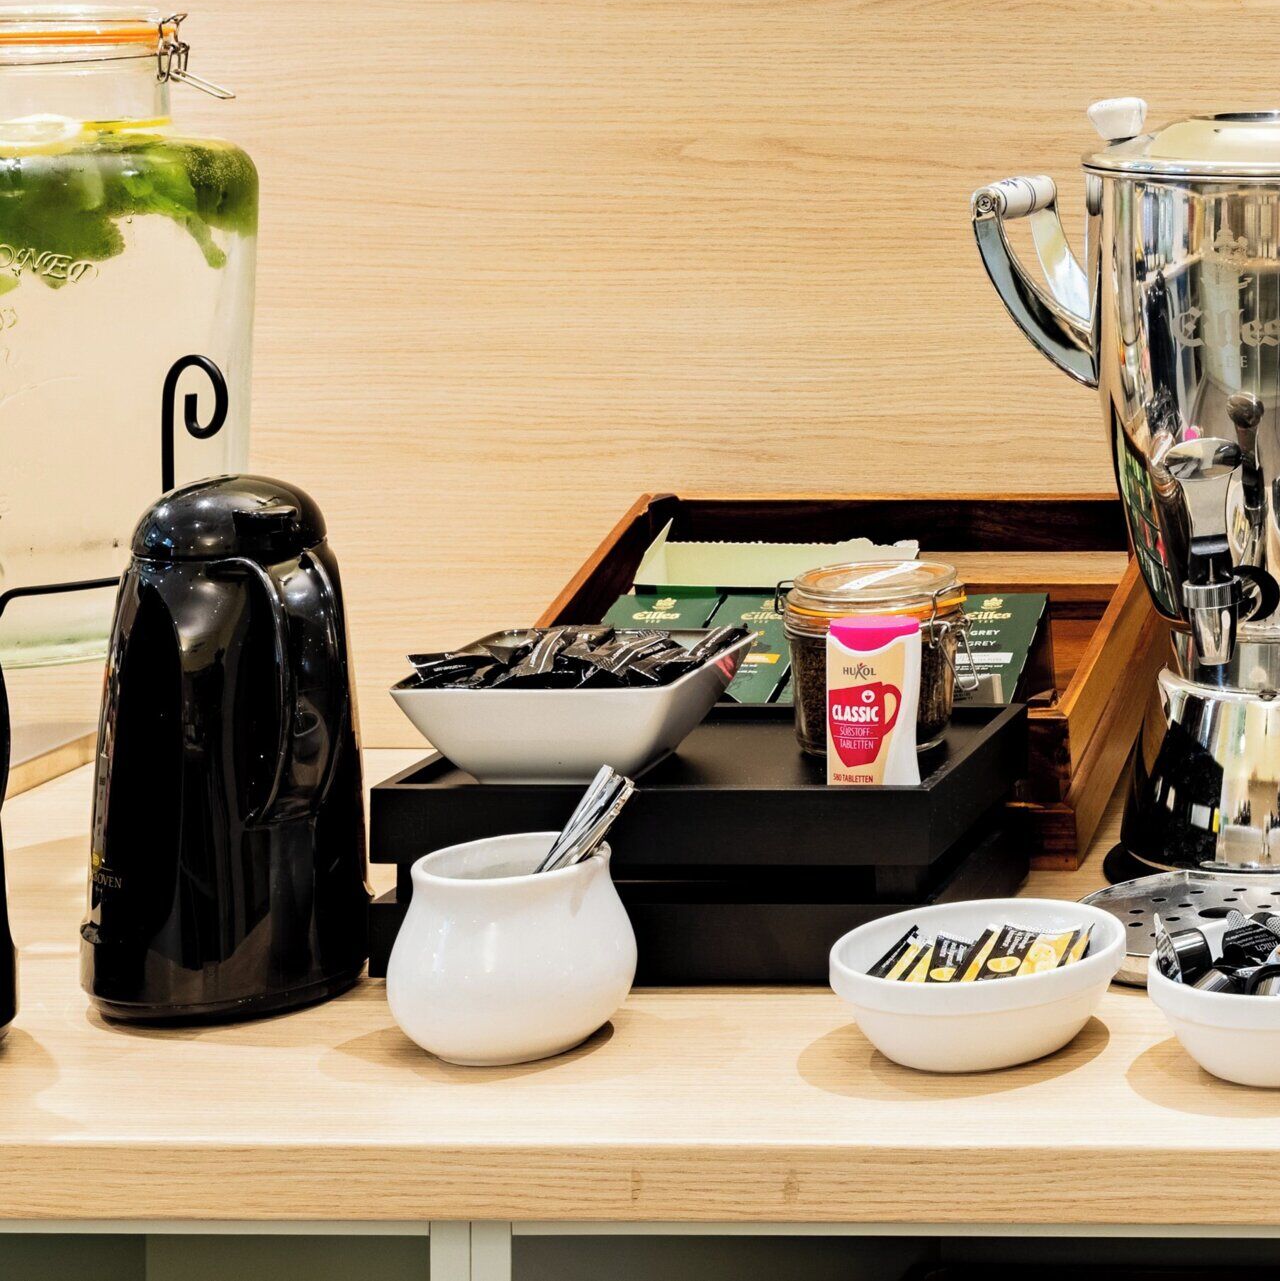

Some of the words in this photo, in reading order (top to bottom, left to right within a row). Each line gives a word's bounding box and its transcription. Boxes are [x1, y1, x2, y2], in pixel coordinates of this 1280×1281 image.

[842, 663, 877, 680] HUXOL
[831, 704, 880, 723] CLASSIC
[839, 738, 874, 750] TABLETTEN
[842, 774, 874, 783] TABLETTEN
